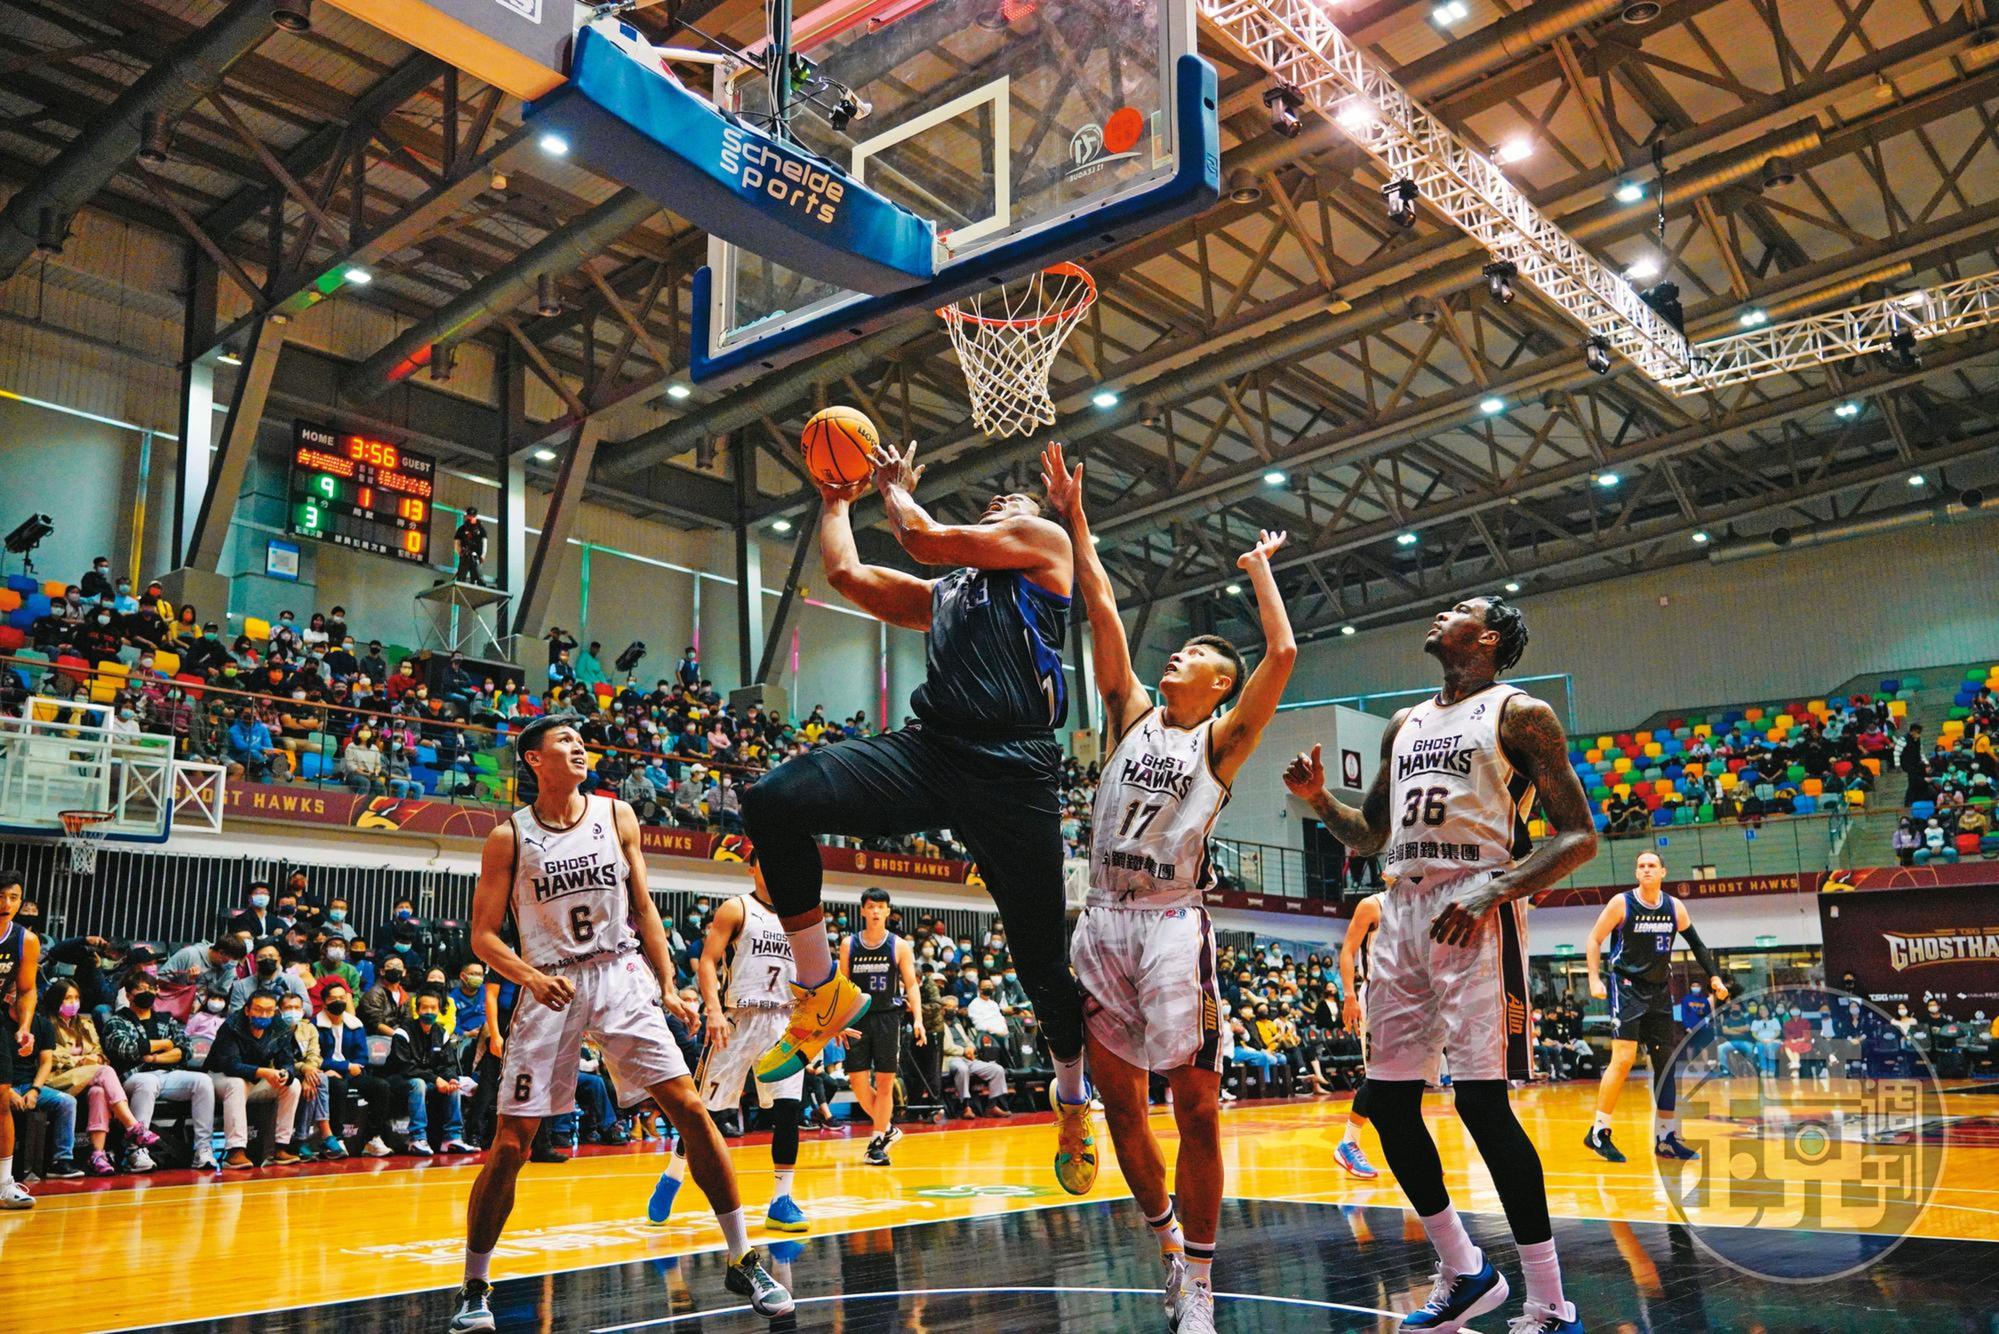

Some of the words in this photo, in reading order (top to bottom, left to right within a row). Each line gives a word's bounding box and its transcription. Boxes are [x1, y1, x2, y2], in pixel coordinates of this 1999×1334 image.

[722, 128, 844, 203] Schelde
[720, 148, 836, 223] Sports
[302, 429, 335, 446] HOME
[351, 438, 395, 468] 3:56
[402, 457, 430, 472] GUEST
[320, 477, 335, 498] 9
[364, 488, 371, 507] 1
[305, 506, 318, 528] 3
[403, 499, 424, 521] 13
[407, 531, 421, 553] 0
[1413, 734, 1463, 752] GHOST
[1141, 752, 1187, 772] GHST
[1398, 748, 1477, 780] HAWKS
[1121, 759, 1194, 800] HAWKS
[254, 792, 325, 814] HAWKS
[1402, 787, 1449, 828] 36
[1119, 801, 1162, 840] 17
[644, 833, 692, 850] HAWKS
[544, 853, 599, 874] GHOST
[873, 858, 911, 873] GHOST
[914, 862, 950, 877] HAWKS
[531, 862, 617, 901] HAWKS
[1699, 881, 1743, 894] GHOST
[1750, 878, 1798, 890] HAWKS
[570, 905, 595, 941] 6
[763, 930, 788, 942] GHOS
[1656, 936, 1671, 951] 23
[751, 938, 792, 957] HAWK
[1882, 933, 1999, 972] GHOSTHA
[768, 966, 781, 993] 7
[870, 976, 887, 991] 25
[514, 1073, 532, 1101] 6
[710, 1081, 720, 1101] 7
